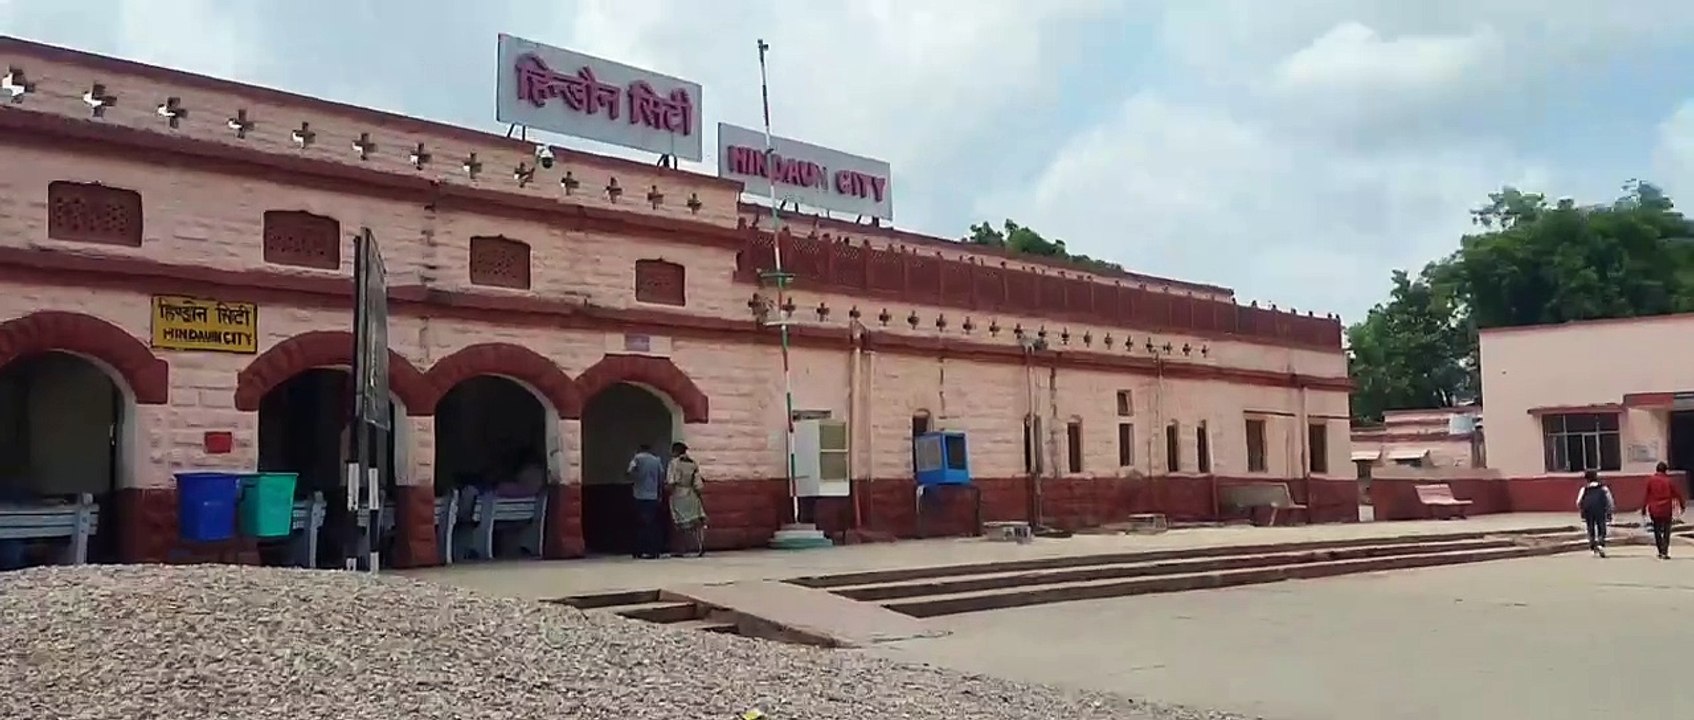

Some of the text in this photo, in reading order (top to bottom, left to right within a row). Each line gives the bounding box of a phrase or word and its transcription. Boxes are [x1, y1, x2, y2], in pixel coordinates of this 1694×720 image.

[627, 80, 692, 136] सिटी
[727, 145, 886, 202] HINDAUN CITY
[222, 331, 252, 345] CITY
